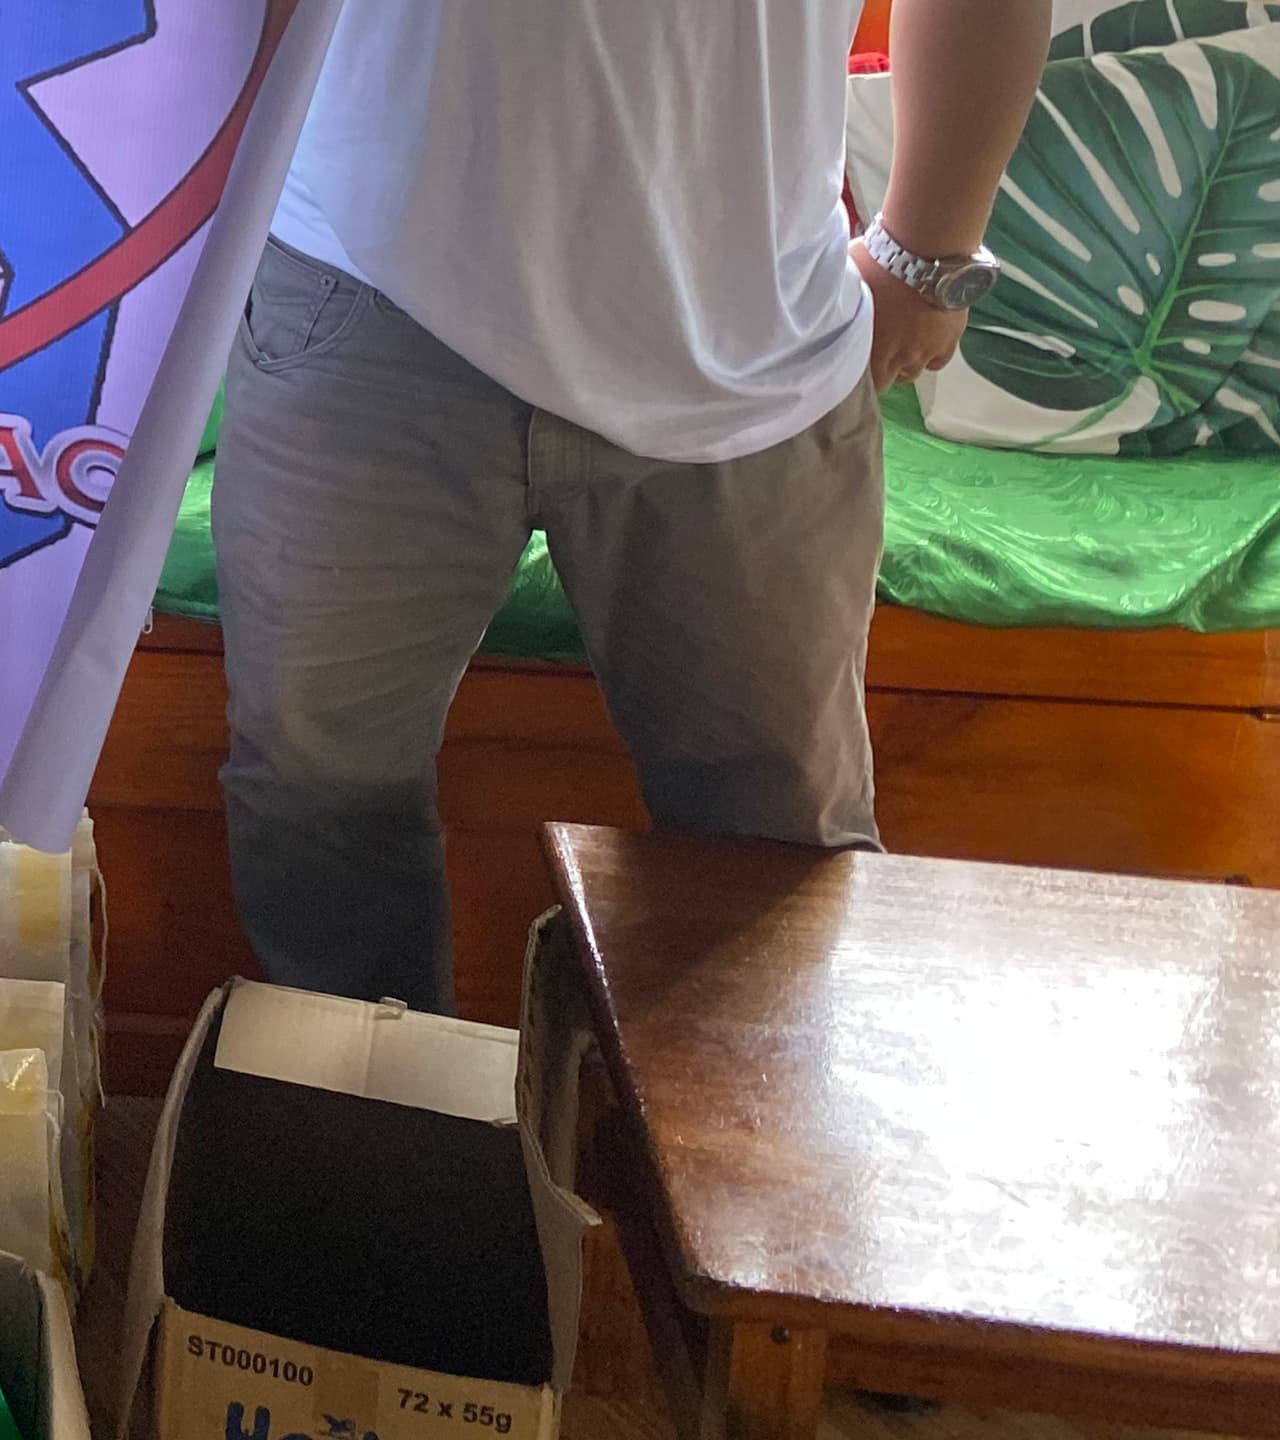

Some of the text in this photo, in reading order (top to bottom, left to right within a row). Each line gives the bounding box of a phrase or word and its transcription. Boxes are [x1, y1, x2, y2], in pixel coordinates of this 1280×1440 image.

[187, 1335, 314, 1387] ST000100
[397, 1388, 513, 1435] 72 x 55g
